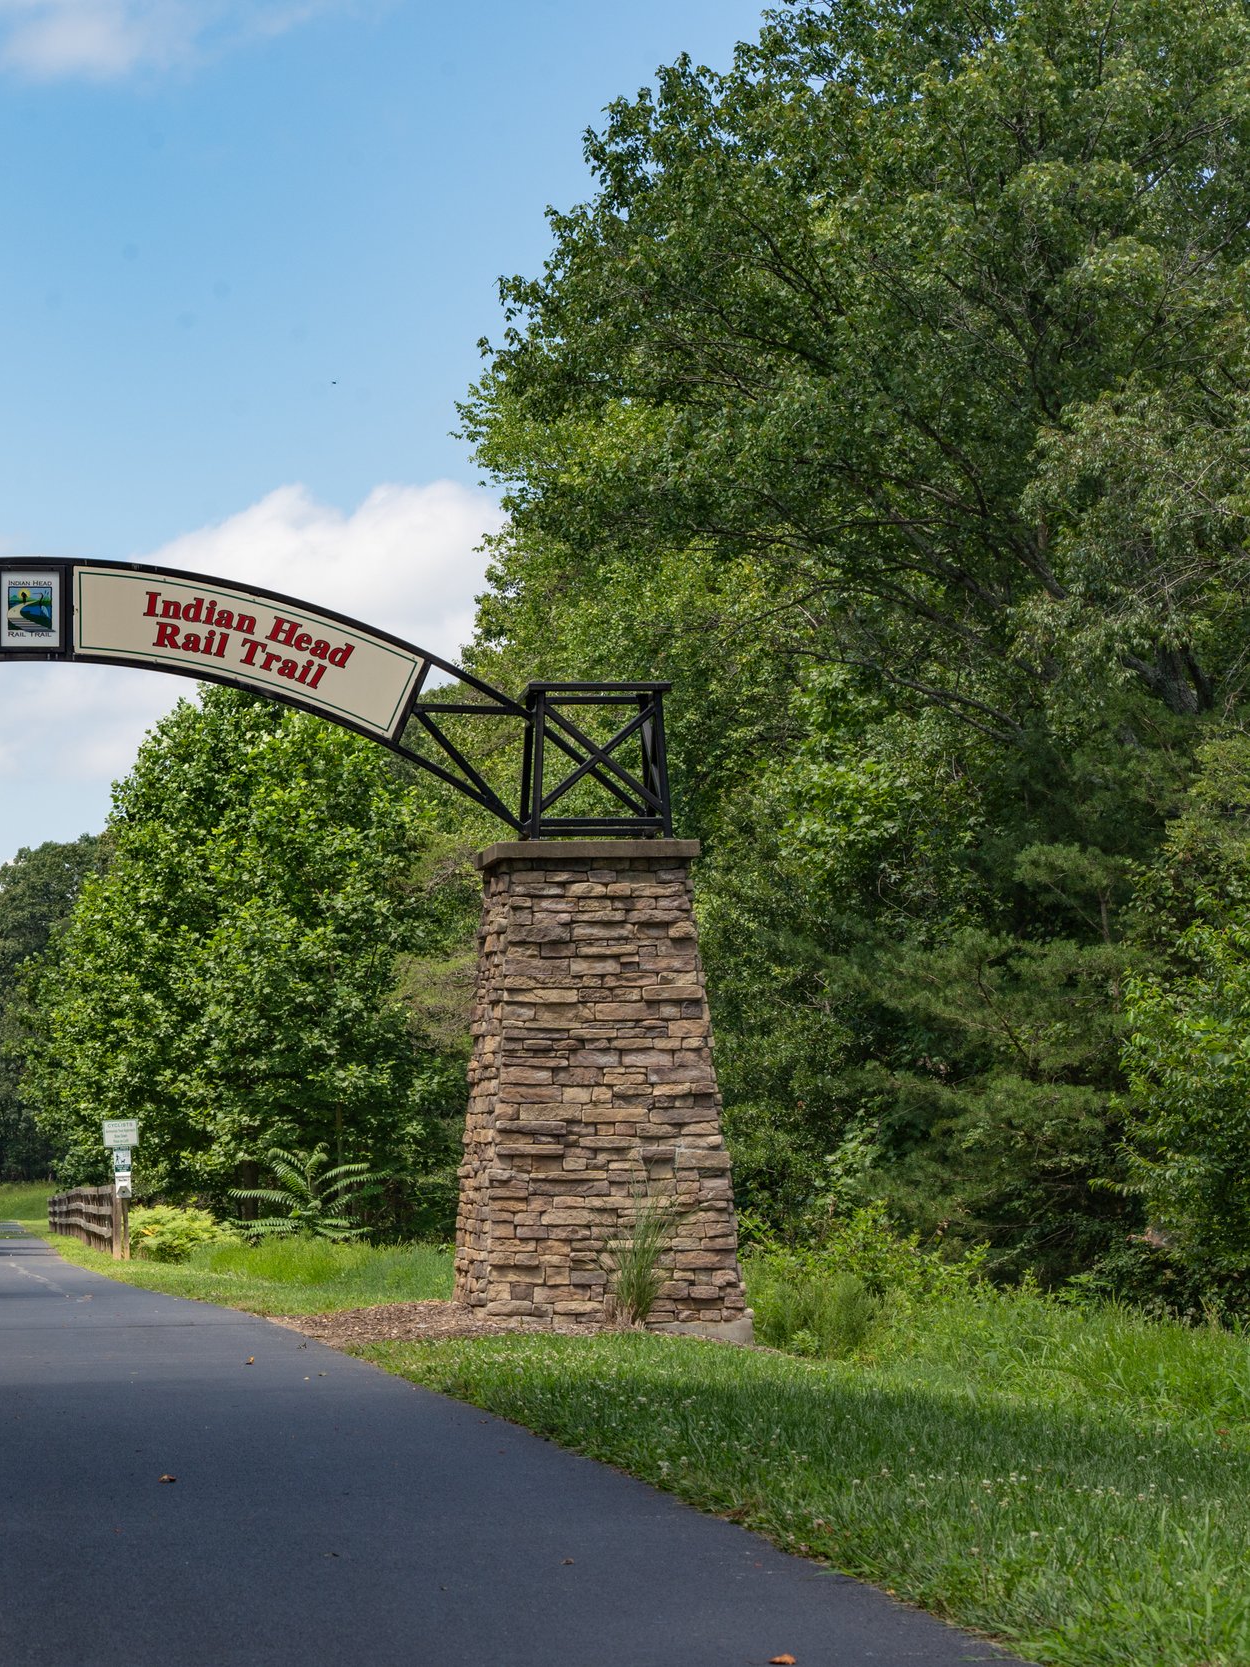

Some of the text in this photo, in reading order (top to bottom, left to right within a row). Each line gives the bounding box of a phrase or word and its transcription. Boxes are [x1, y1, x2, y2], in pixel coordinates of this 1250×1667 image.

[142, 591, 356, 669] Indian Head
[152, 621, 327, 690] Rail Trail
